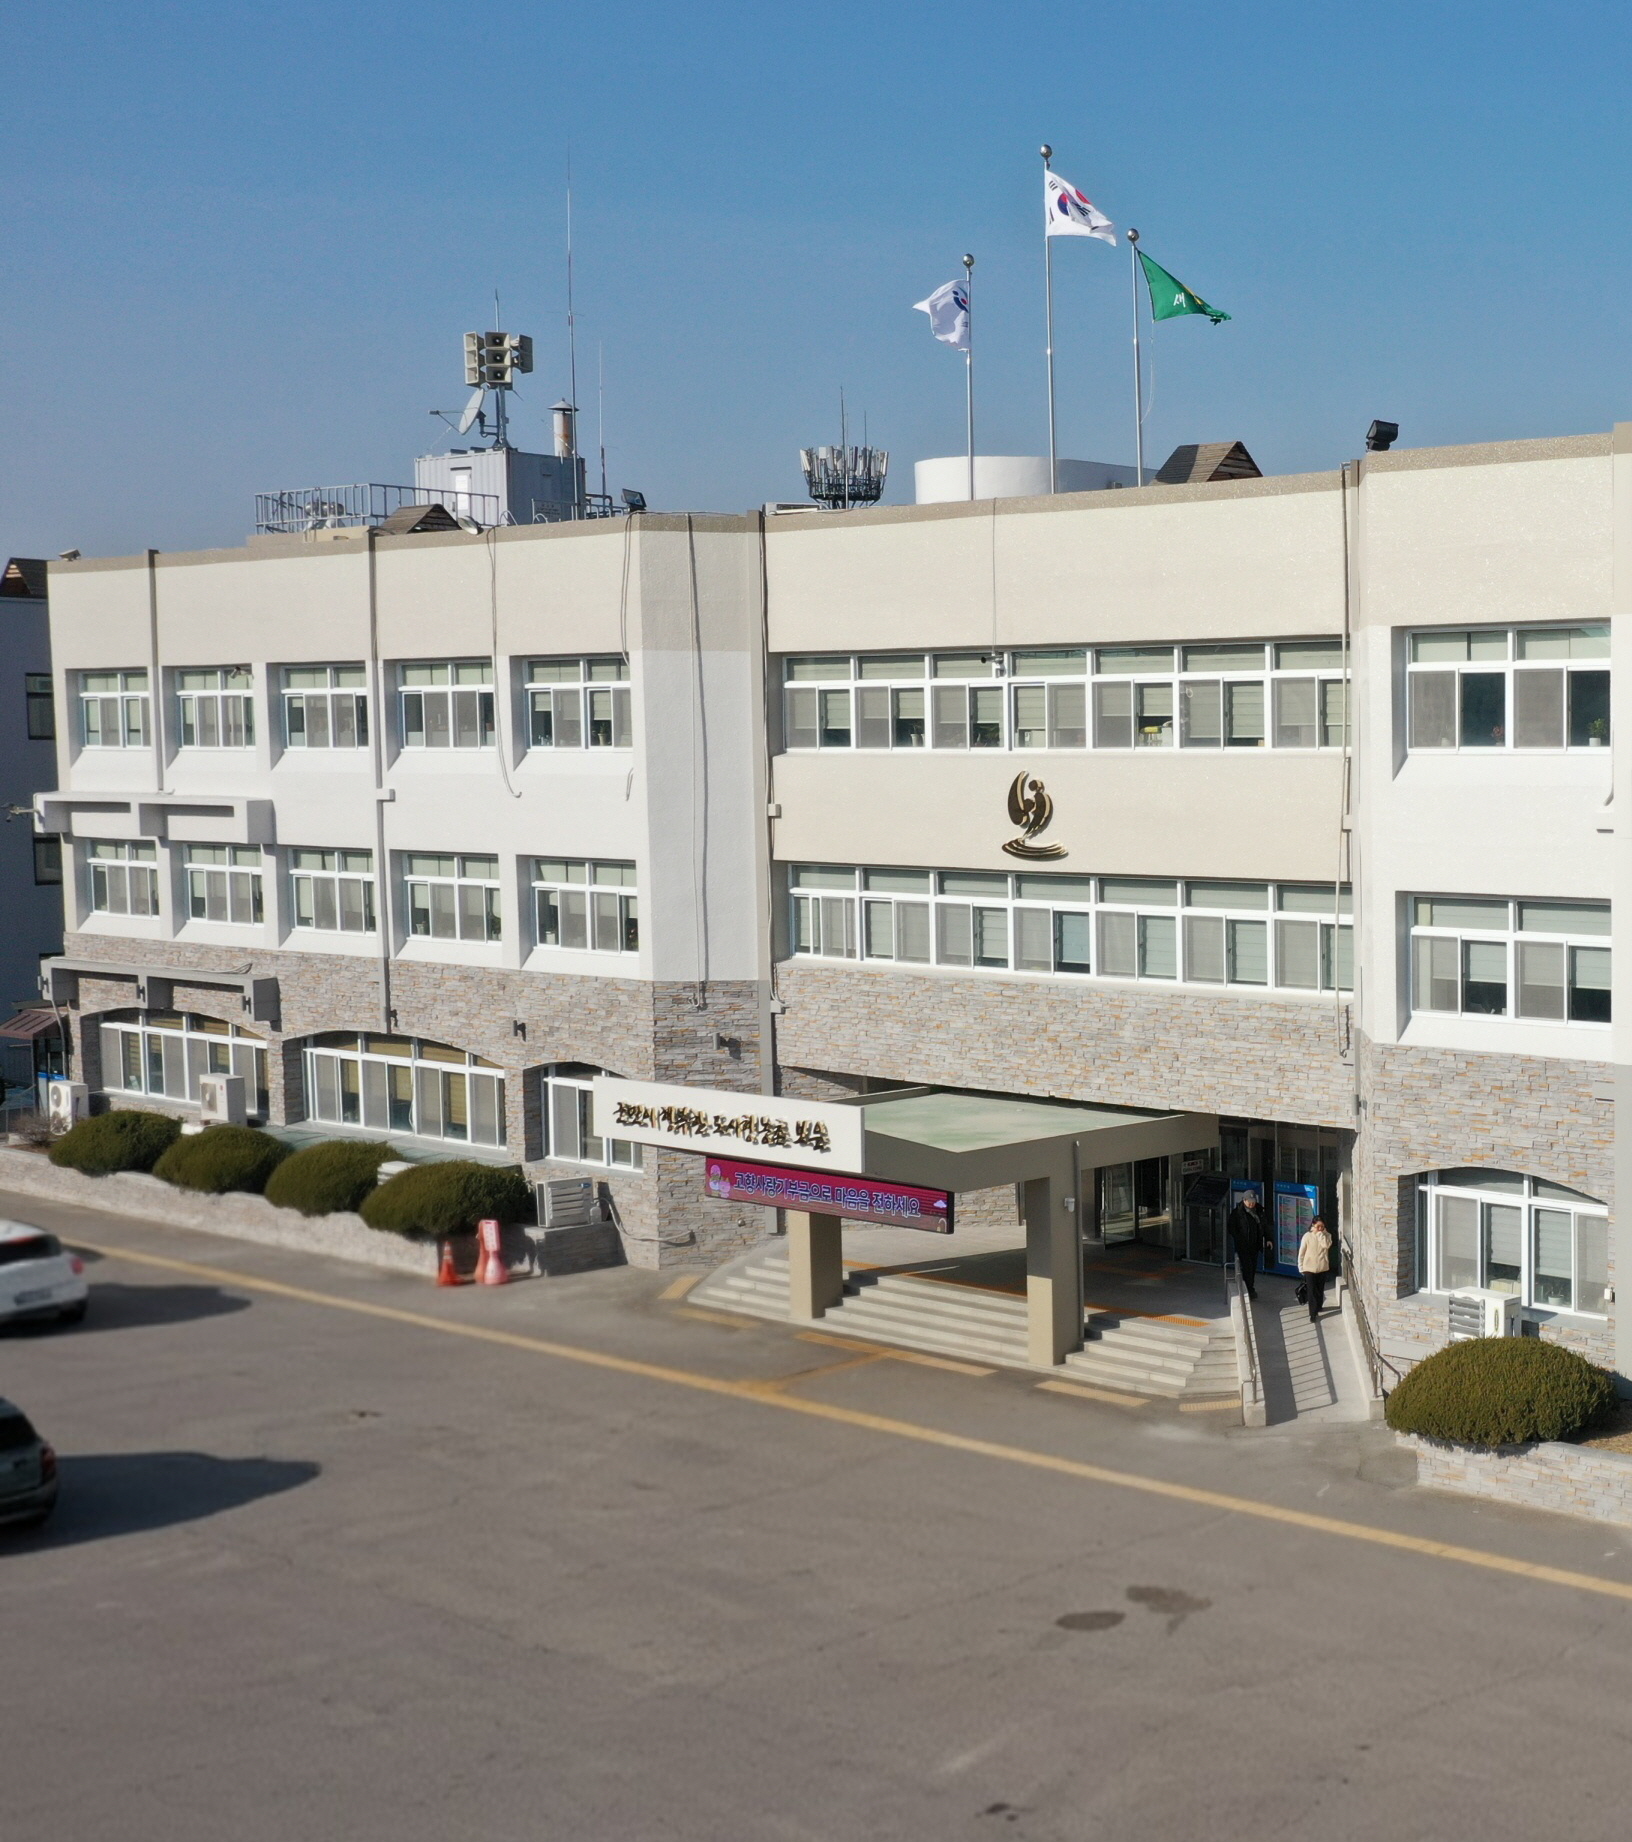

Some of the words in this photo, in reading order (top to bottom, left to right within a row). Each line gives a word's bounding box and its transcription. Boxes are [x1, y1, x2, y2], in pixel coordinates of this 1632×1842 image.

[733, 1172, 833, 1204] 고향사랑기부금으로
[835, 1187, 869, 1211] 마음을
[872, 1192, 921, 1218] 전하세요
